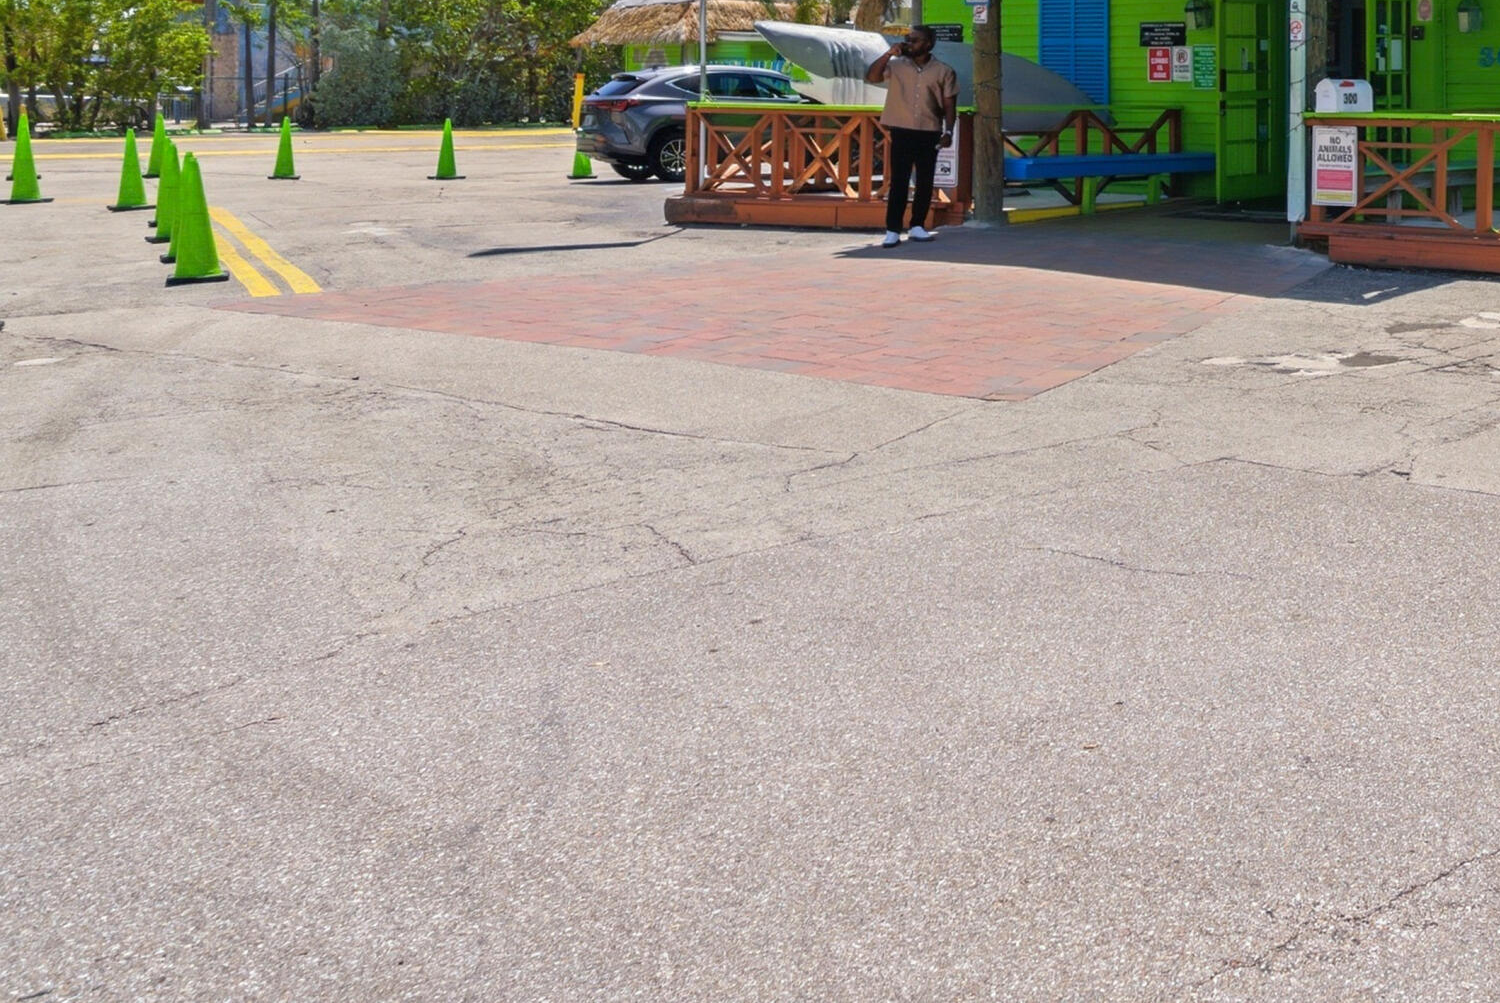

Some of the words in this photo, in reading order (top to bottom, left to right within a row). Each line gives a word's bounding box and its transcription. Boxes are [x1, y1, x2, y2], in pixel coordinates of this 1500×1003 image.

[1329, 136, 1341, 145] NO
[1318, 145, 1352, 154] ANIMALS
[1317, 154, 1353, 163] ALLOWED
